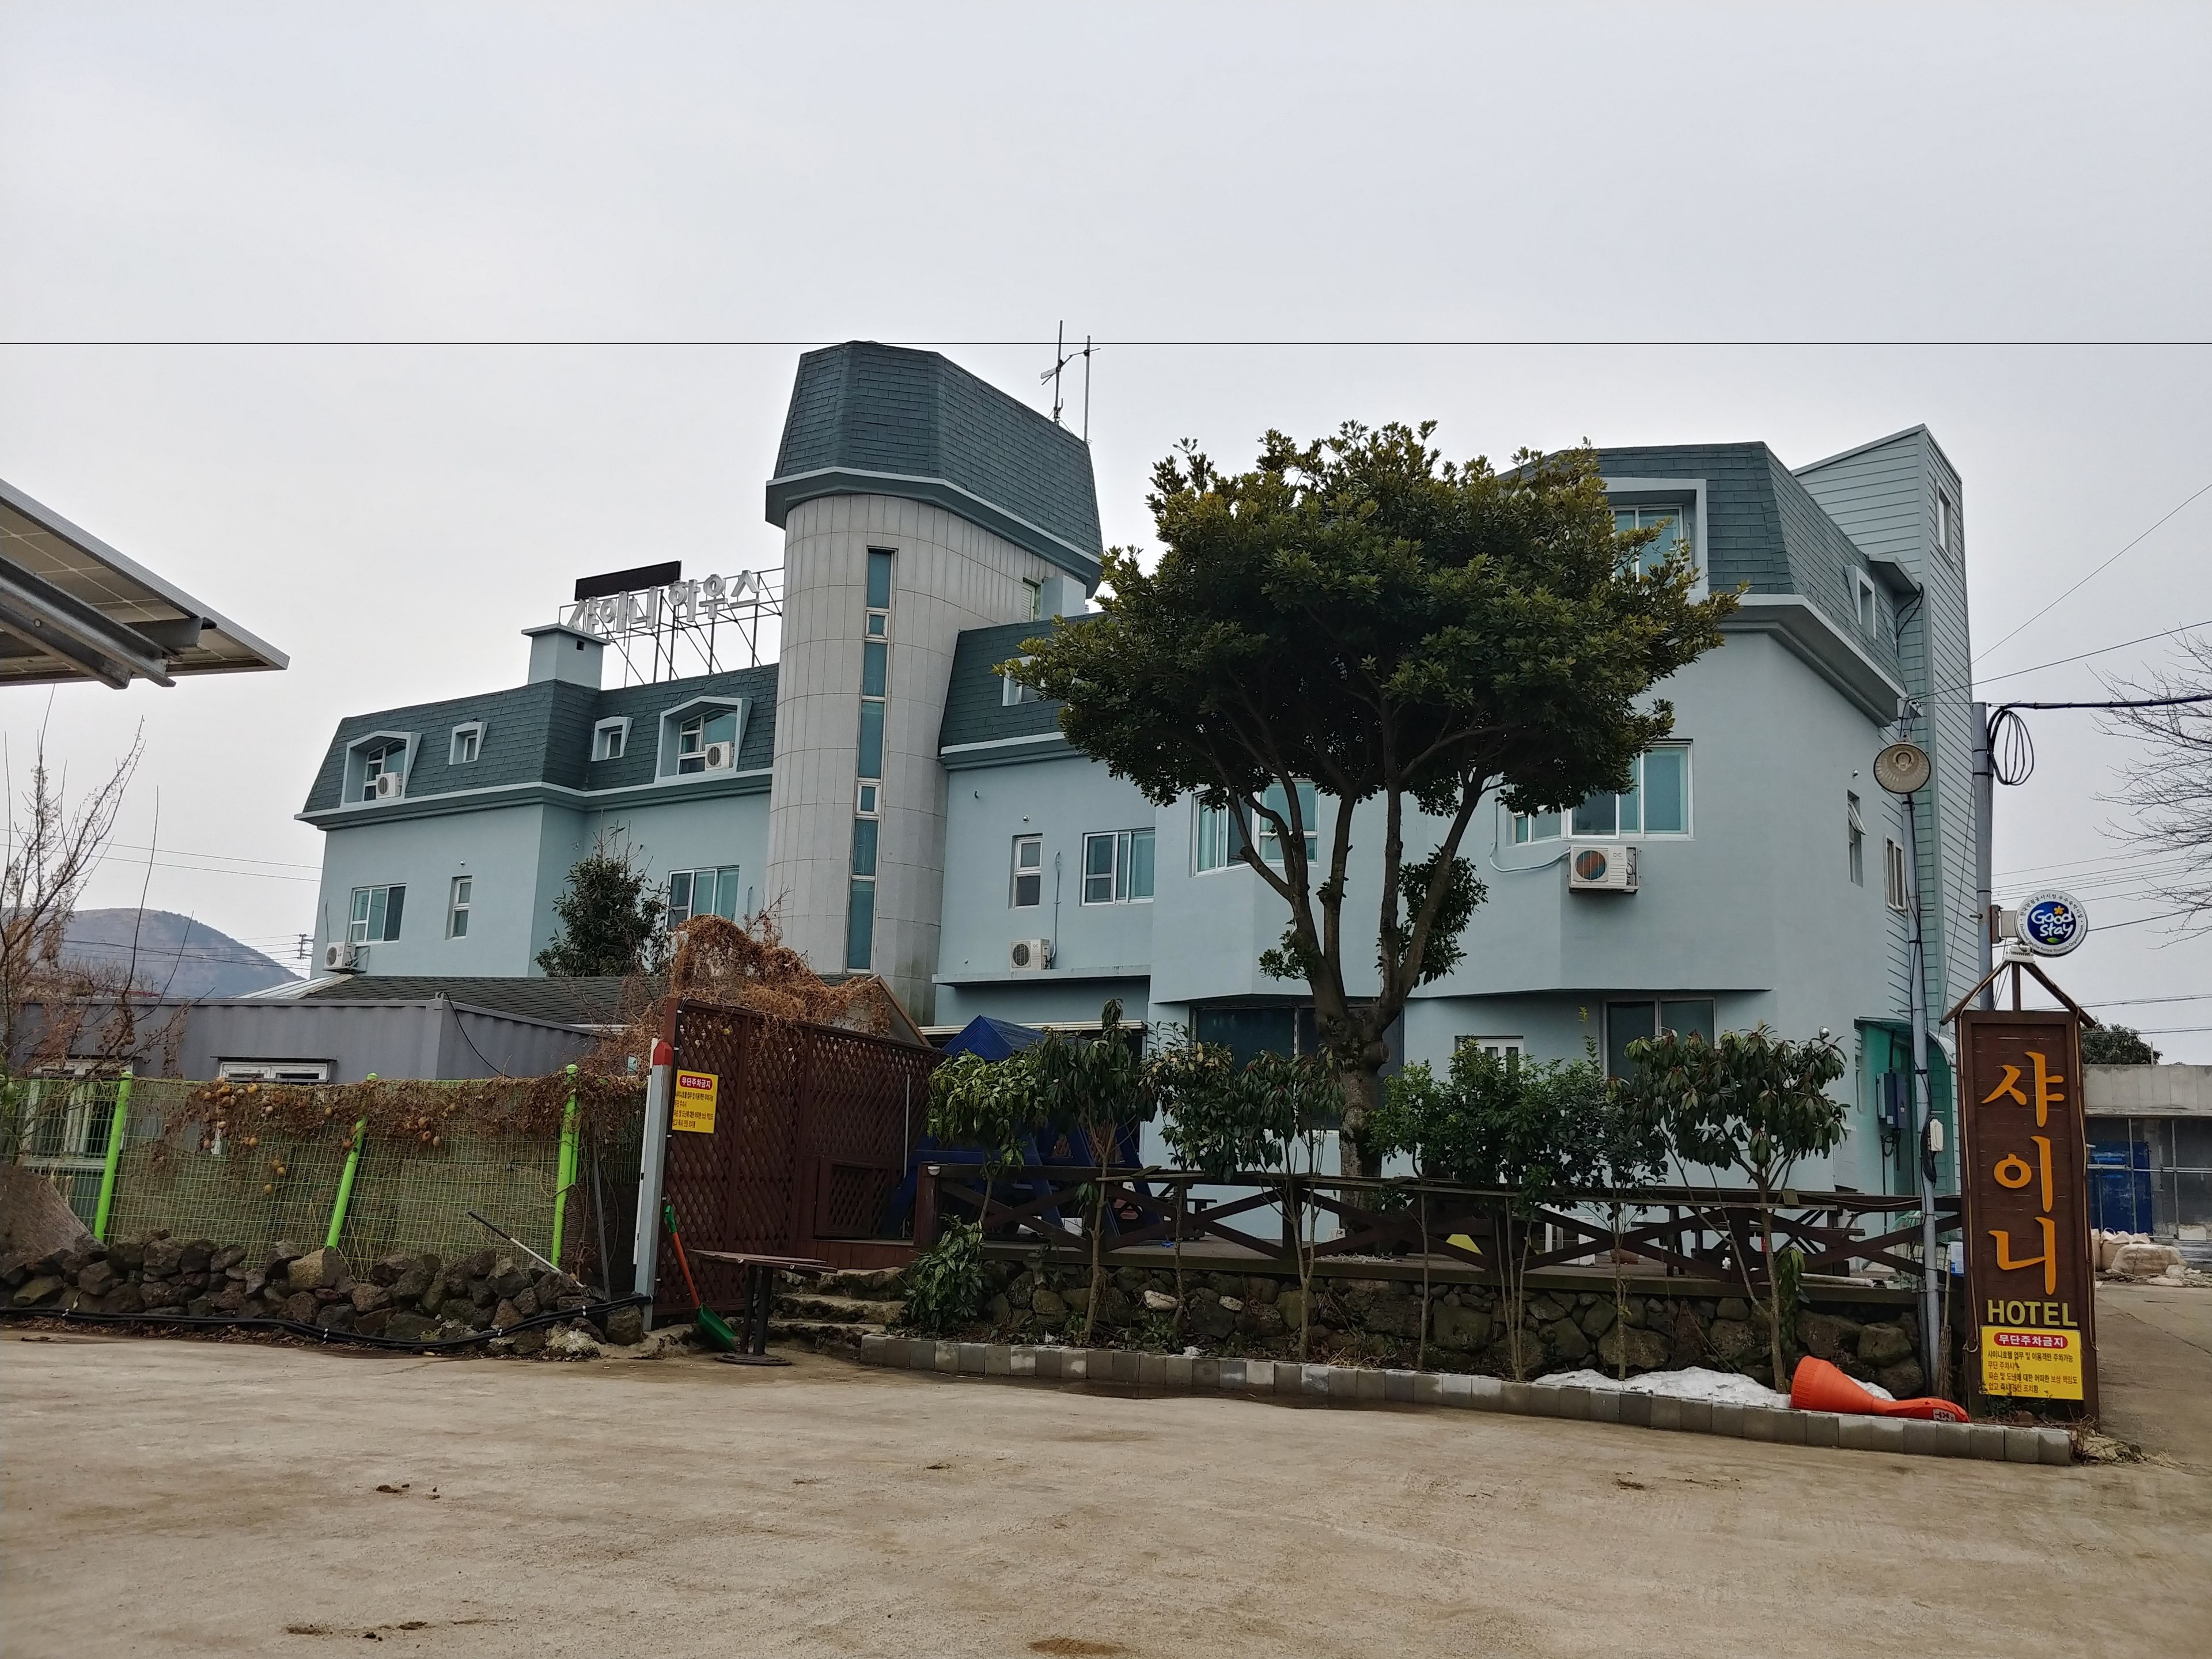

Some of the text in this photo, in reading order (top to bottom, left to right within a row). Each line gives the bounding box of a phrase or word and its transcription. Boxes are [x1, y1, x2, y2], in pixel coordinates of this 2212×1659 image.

[668, 569, 760, 623] 하우스
[2031, 910, 2074, 925] Good
[681, 1077, 711, 1089] 무단주차금지
[1981, 1051, 2065, 1296] 샤이니
[1987, 1299, 2078, 1327] HOTEL
[1998, 1334, 2064, 1348] 무단주차금지
[1987, 1350, 2074, 1363] 샤이니호텔 업무 및 이용객만 주차가능
[1988, 1361, 2014, 1370] 무단 주차시
[1988, 1372, 1998, 1380] 파손
[1999, 1372, 2005, 1380] 및
[2022, 1374, 2033, 1382] 대한
[2035, 1374, 2050, 1383] 어떠한
[2051, 1376, 2061, 1384] 보상
[2062, 1376, 2078, 1384] 책임도
[2023, 1384, 2039, 1393] 조치함
